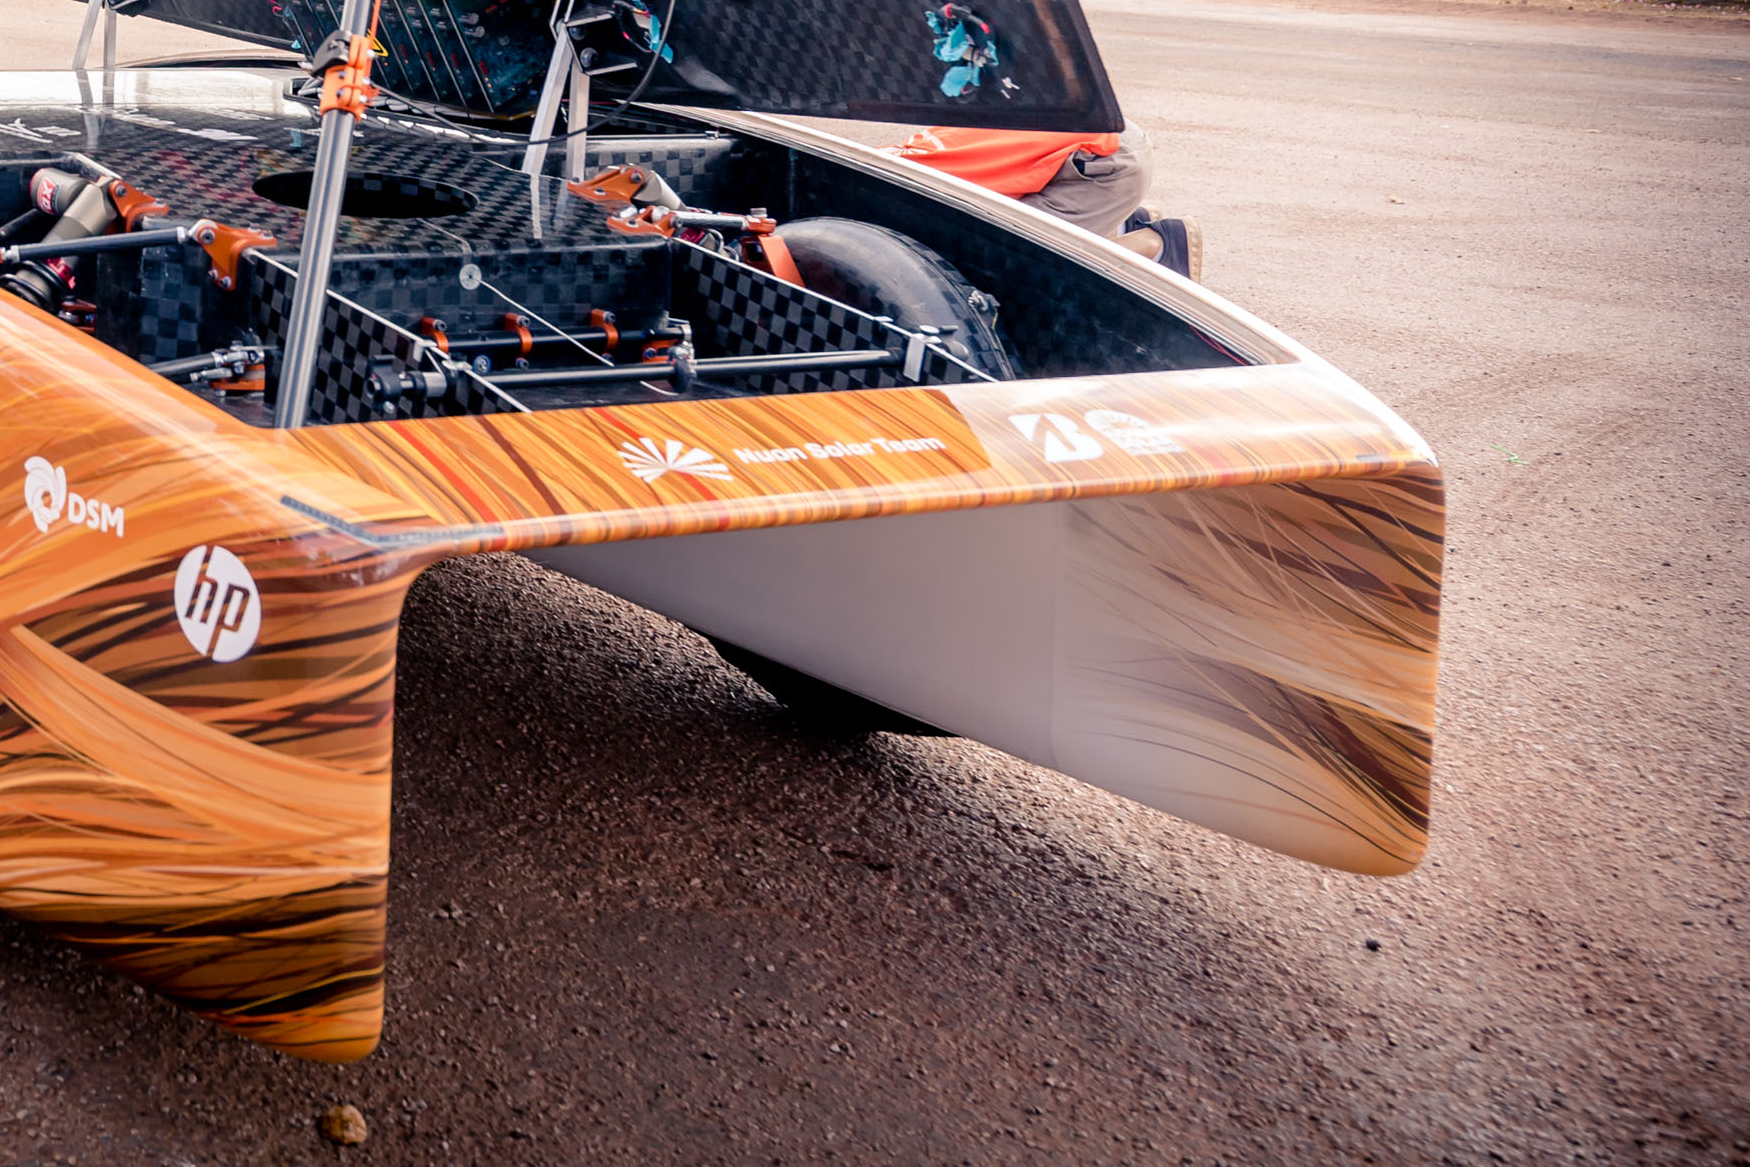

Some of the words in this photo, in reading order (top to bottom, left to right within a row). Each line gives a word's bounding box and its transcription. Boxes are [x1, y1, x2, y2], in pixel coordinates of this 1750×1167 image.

[732, 447, 808, 464] Nuon
[803, 440, 875, 459] Solar
[870, 437, 947, 453] Team
[68, 492, 125, 538] DSM
[184, 544, 251, 656] hp
